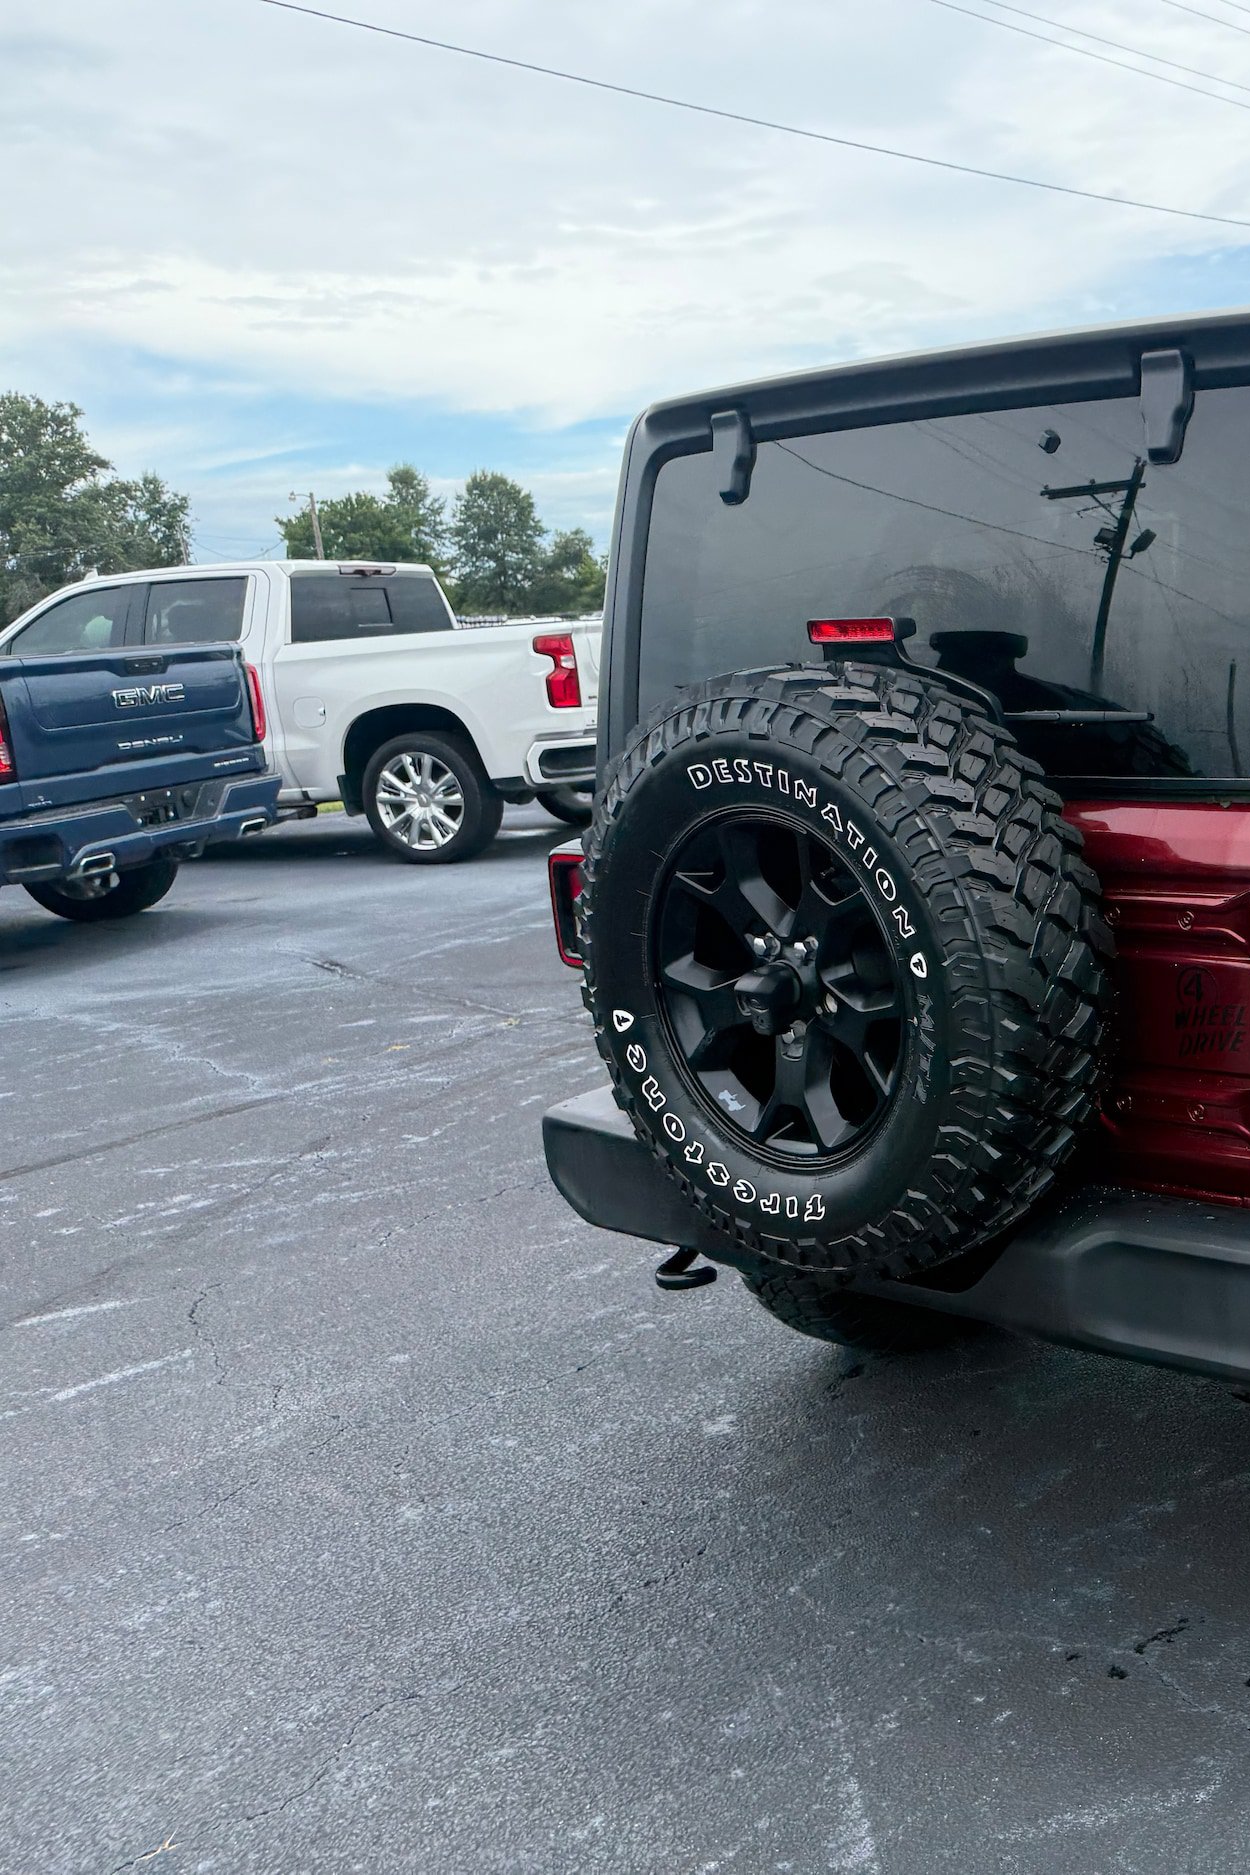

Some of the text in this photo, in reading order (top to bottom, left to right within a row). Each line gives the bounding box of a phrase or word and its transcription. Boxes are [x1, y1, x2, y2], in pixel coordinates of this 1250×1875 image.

[112, 683, 185, 708] GMC
[687, 758, 916, 939] DESTINATION
[1174, 1004, 1247, 1029] WHEEL
[1179, 1029, 1247, 1057] DRIVE
